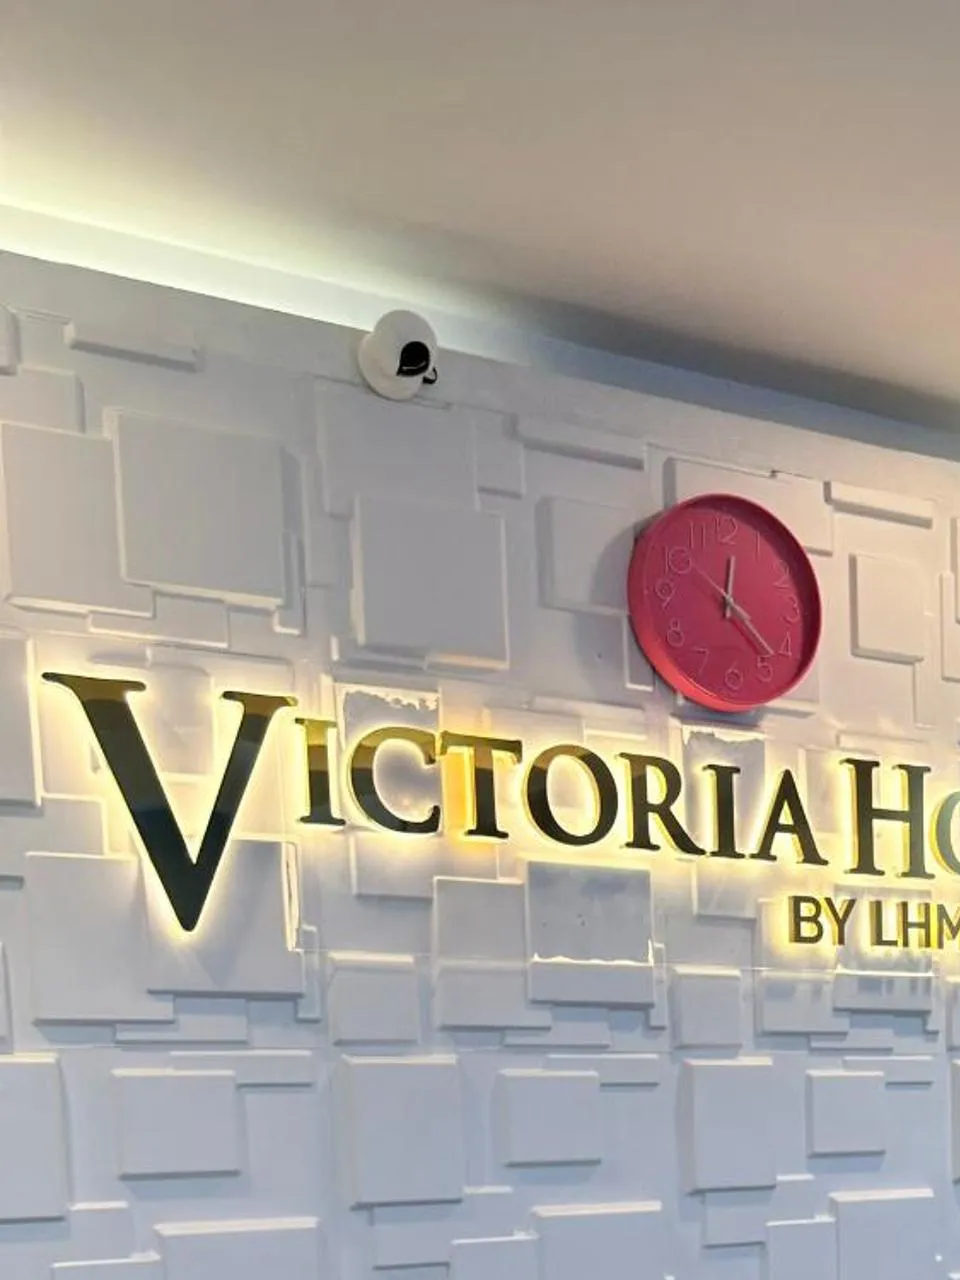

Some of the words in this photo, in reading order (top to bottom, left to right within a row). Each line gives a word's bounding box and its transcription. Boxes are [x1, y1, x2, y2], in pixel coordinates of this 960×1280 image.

[689, 520, 706, 548] 11
[715, 516, 738, 545] 12
[664, 546, 692, 574] 10
[724, 661, 744, 690] 6
[41, 671, 829, 932] VICTORIA
[788, 896, 856, 946] BY
